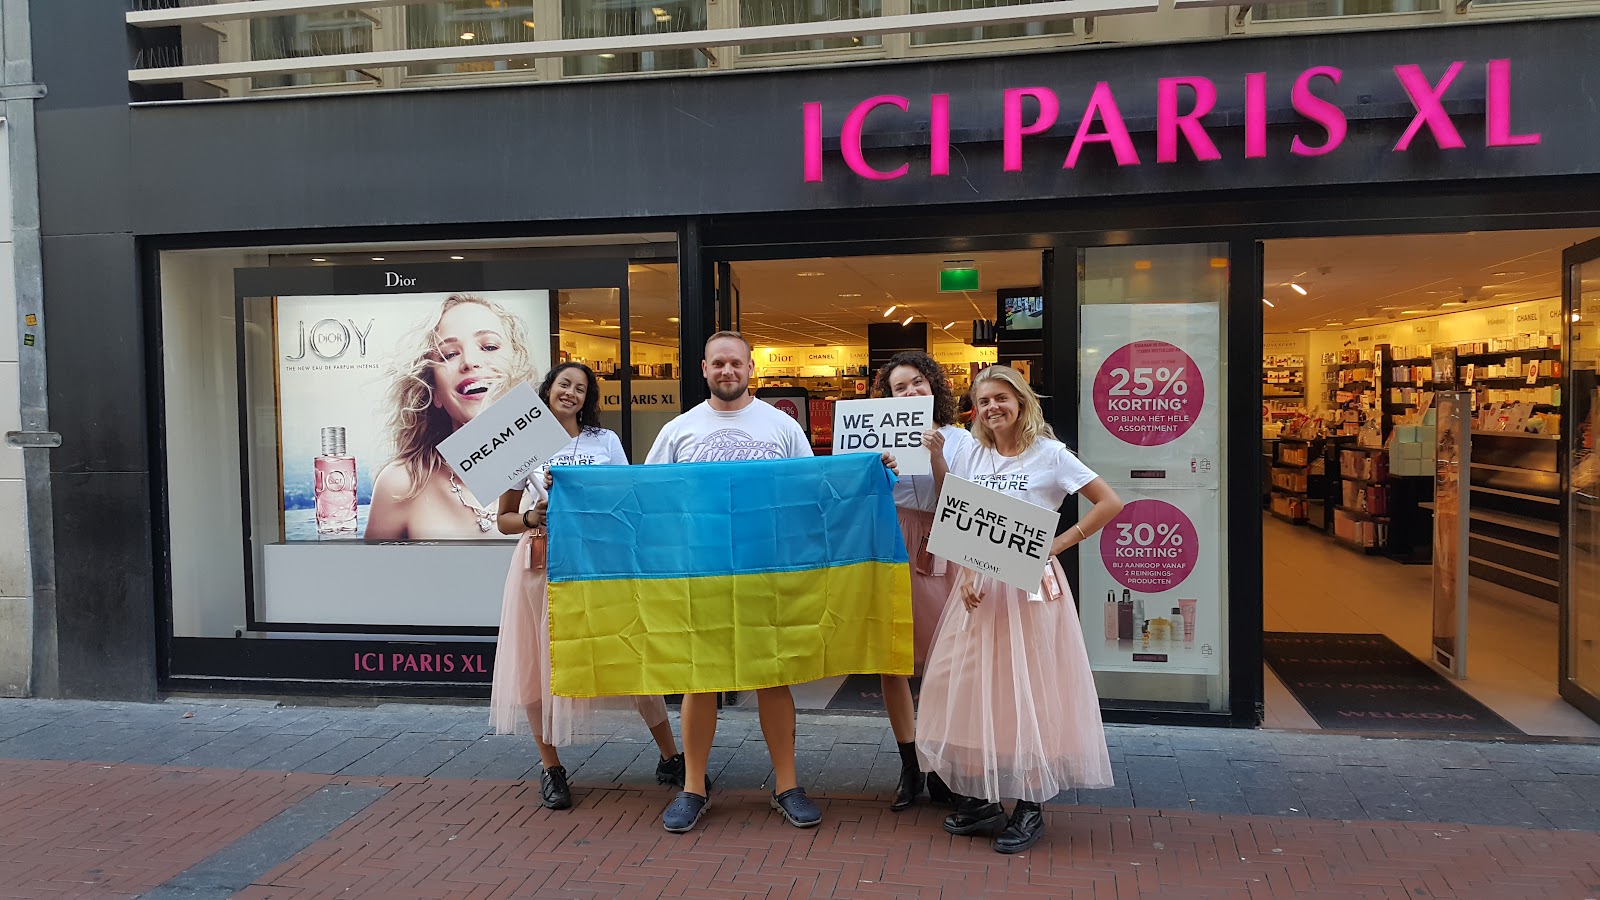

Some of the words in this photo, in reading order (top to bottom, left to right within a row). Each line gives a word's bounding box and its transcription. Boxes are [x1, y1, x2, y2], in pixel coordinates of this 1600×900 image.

[803, 93, 950, 183] ICI
[1002, 65, 1348, 173] PARIS
[1393, 58, 1542, 152] XL
[385, 271, 417, 287] Dior
[285, 318, 375, 361] JOY
[769, 353, 793, 363] Dior
[1108, 367, 1188, 397] 25%
[604, 395, 620, 405] ICI
[630, 394, 658, 405] ARIS
[661, 394, 675, 404] XL
[843, 414, 874, 429] WE
[880, 411, 924, 427] ARE
[1107, 415, 1120, 423] OP
[1121, 415, 1147, 423] BIJNA
[460, 427, 515, 472] DREAM
[514, 406, 542, 431] BIG
[712, 441, 731, 449] LOS
[733, 440, 778, 450] ANGELES
[841, 428, 923, 450] IDÔLES
[946, 495, 970, 513] WE
[974, 507, 1007, 528] ARE
[1014, 520, 1047, 542] THE
[940, 507, 1043, 560] FUTURE
[1116, 523, 1183, 547] 30%
[354, 652, 384, 672] ICI
[392, 653, 455, 672] PARIS
[461, 654, 487, 673] XL
[1336, 709, 1477, 721] WELKOM
